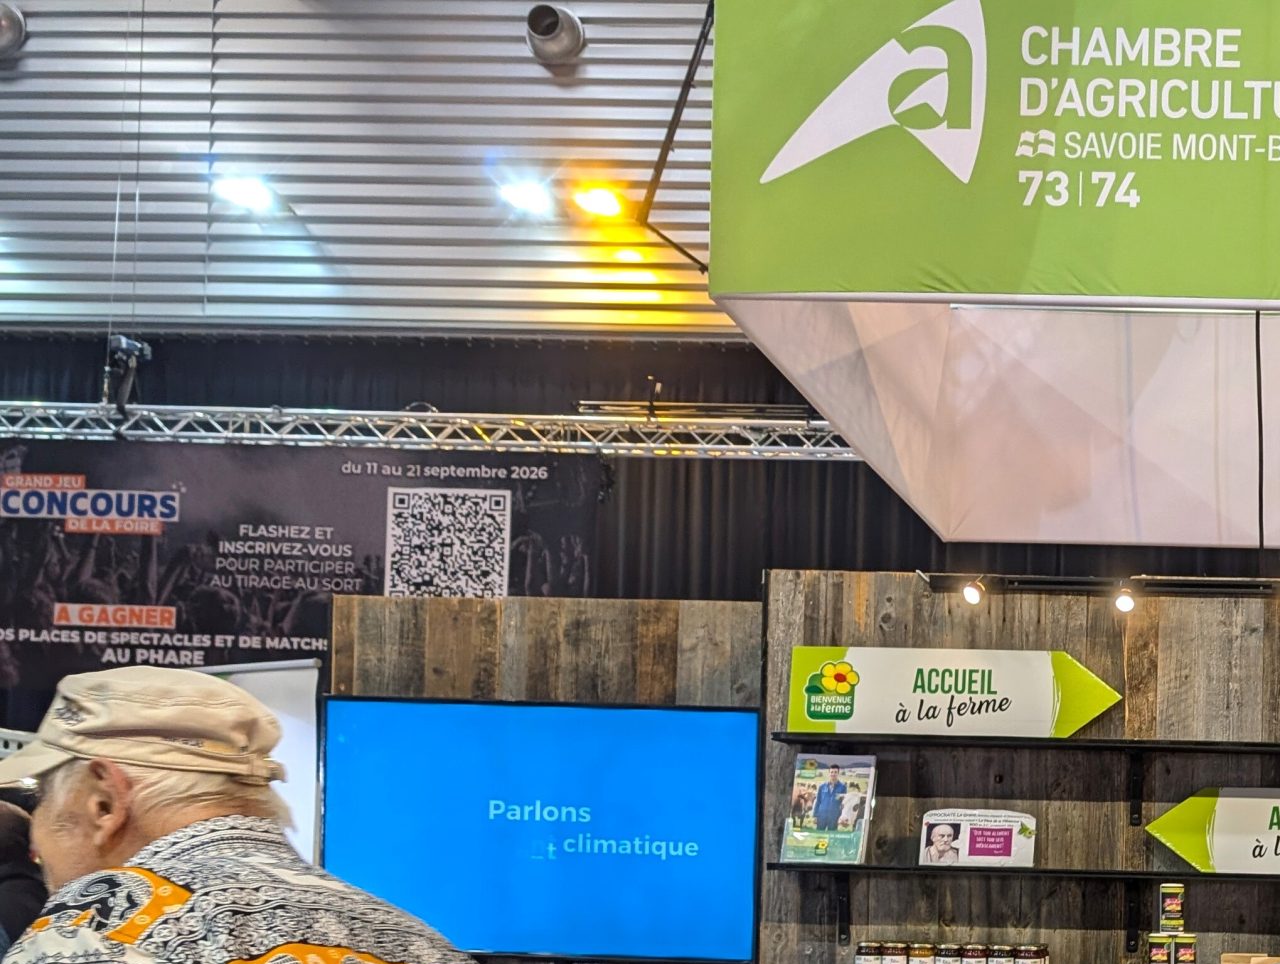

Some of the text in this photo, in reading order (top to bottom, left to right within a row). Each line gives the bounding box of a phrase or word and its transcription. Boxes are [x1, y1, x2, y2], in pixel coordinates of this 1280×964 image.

[1021, 26, 1242, 67] CHAMBRE
[1064, 131, 1162, 159] SAVOIE
[1018, 170, 1141, 208] 73 74
[341, 461, 548, 479] du 11 au 21 septembre 2026
[5, 475, 81, 488] GRAND JEU
[2, 490, 177, 518] CONCOURS
[69, 520, 159, 532] DE LA FOIRE
[239, 524, 334, 539] FLASHEZ ET
[219, 541, 352, 557] INSCRIVEZ-VOUS
[216, 558, 354, 574] POUR PARTICIPER
[211, 575, 362, 592] AU TIRAGE AU SORT
[79, 605, 175, 627] GAGNER
[18, 629, 80, 643] PLACES
[85, 630, 107, 643] DE
[111, 632, 211, 647] SPECTACLES
[214, 634, 234, 647] ET
[238, 635, 261, 648] DE
[101, 648, 204, 666] AU PHARE
[912, 668, 997, 695] ACCUEIL
[811, 695, 852, 704] BIENVENUE
[821, 702, 851, 714] ferme
[895, 694, 1012, 727] à la ferme
[488, 800, 591, 823] Parlons
[563, 834, 700, 861] climatique
[1252, 838, 1268, 859] à
